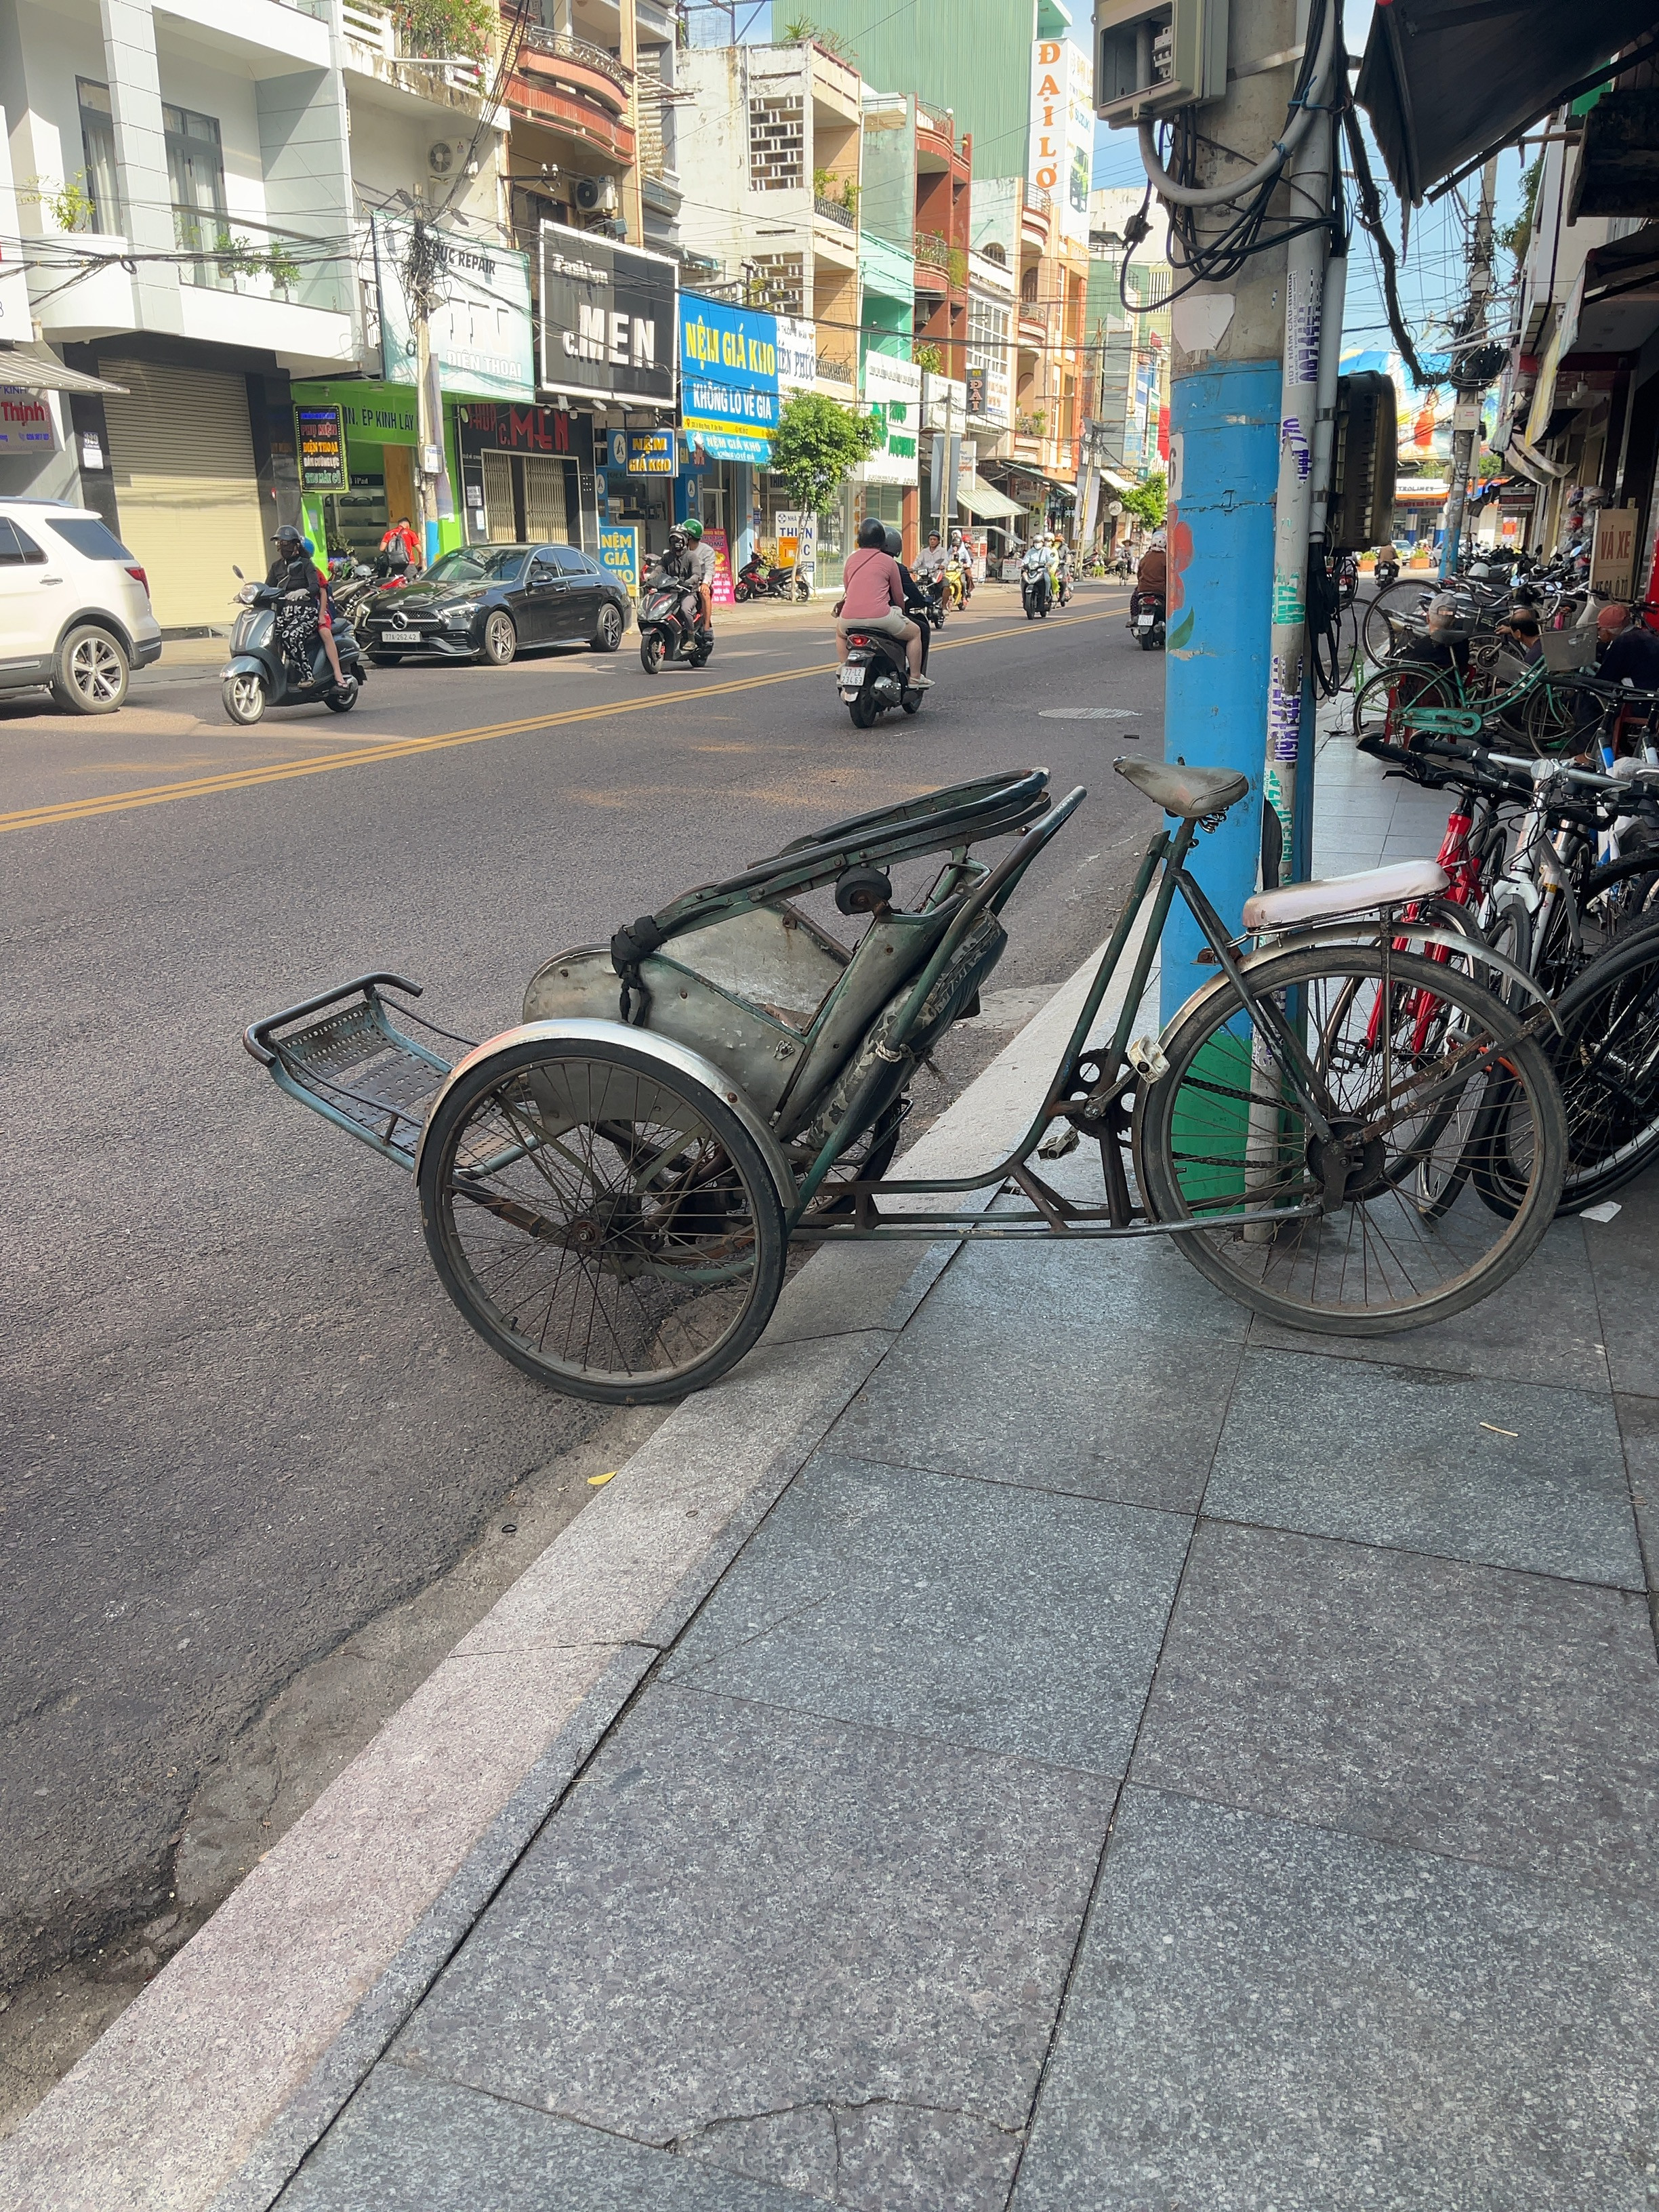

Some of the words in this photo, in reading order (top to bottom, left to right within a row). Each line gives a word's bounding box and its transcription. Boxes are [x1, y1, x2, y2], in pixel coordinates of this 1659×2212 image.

[1037, 43, 1061, 127] ĐẠI
[458, 251, 496, 275] REPAIR
[685, 314, 720, 371] NỆM
[722, 323, 747, 370] GIÁ
[748, 338, 775, 377] KHO
[447, 350, 481, 373] ĐIỆN
[483, 356, 522, 381] THOẠI
[693, 381, 729, 413] KHÔNG
[730, 388, 741, 415] LO
[743, 384, 755, 417] VỀ
[1, 401, 45, 426] Thịnh
[363, 405, 373, 427] ÉP
[375, 408, 397, 429] KÍNH
[399, 410, 414, 432] LẤY
[632, 434, 668, 455] NỆM
[706, 434, 726, 450] NỆM
[726, 436, 743, 451] GIÁ
[743, 441, 761, 453] KHO
[629, 454, 647, 472] GIÁ
[648, 458, 672, 472] KHO
[601, 531, 632, 549] NỆM
[779, 525, 813, 539] THIN
[1601, 525, 1614, 560] VÁ
[1616, 530, 1632, 559] XE
[604, 548, 630, 566] GIÁ
